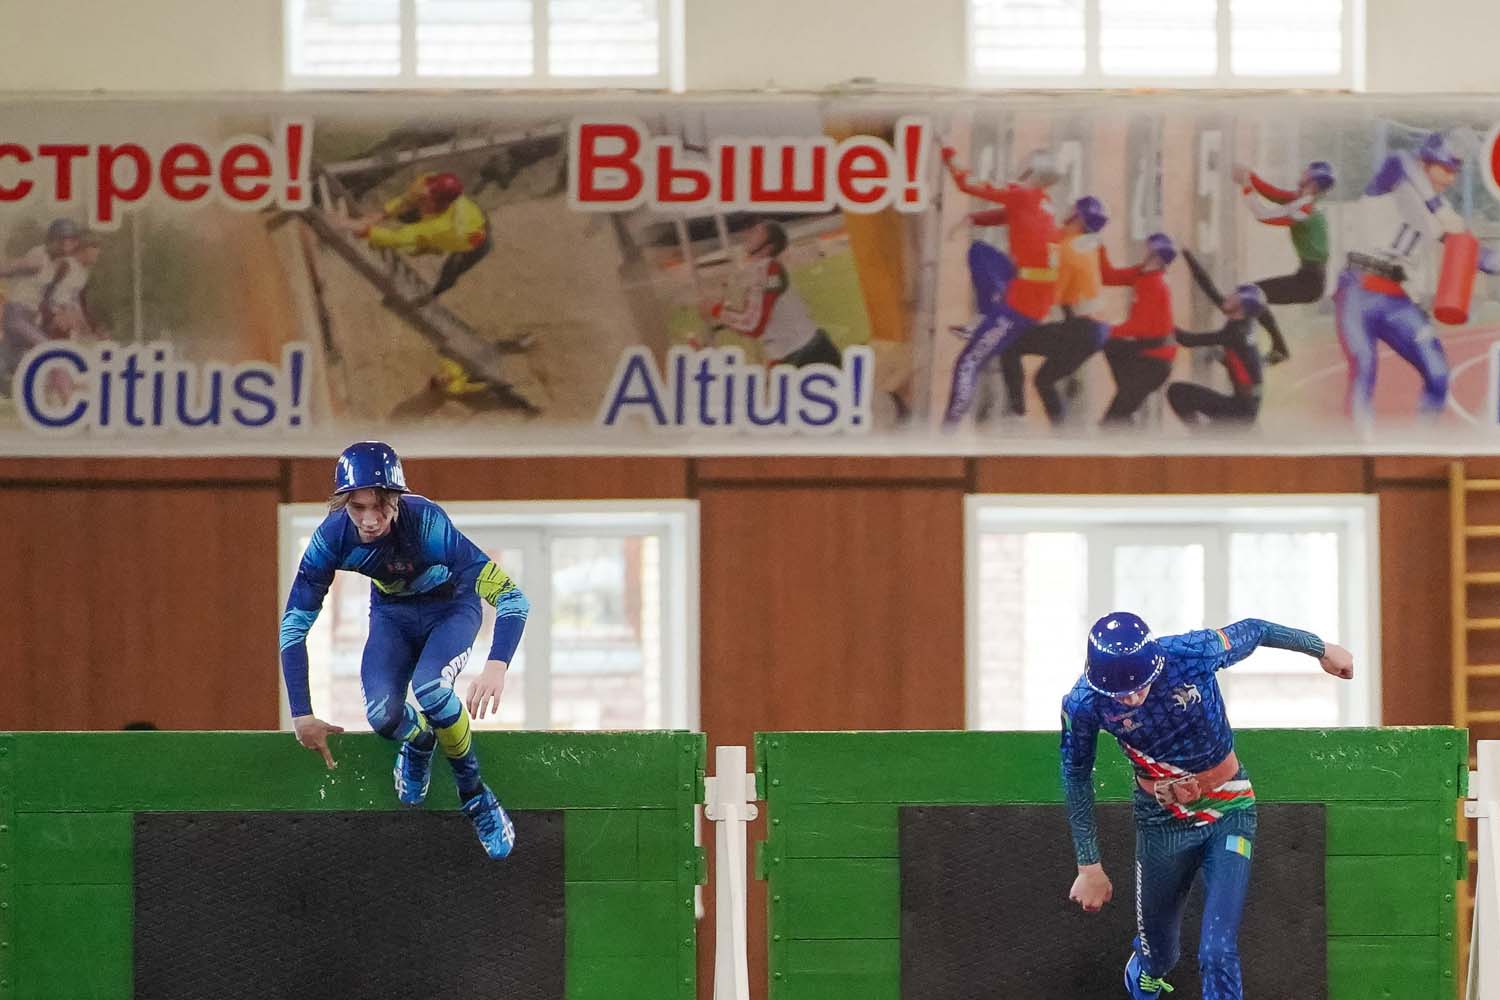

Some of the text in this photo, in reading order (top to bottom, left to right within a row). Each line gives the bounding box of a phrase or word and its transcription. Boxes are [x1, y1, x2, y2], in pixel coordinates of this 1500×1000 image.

[0, 124, 303, 223] стрее!
[578, 124, 921, 204] Выше!
[22, 349, 304, 428] Citius!
[603, 355, 865, 427] Altius!
